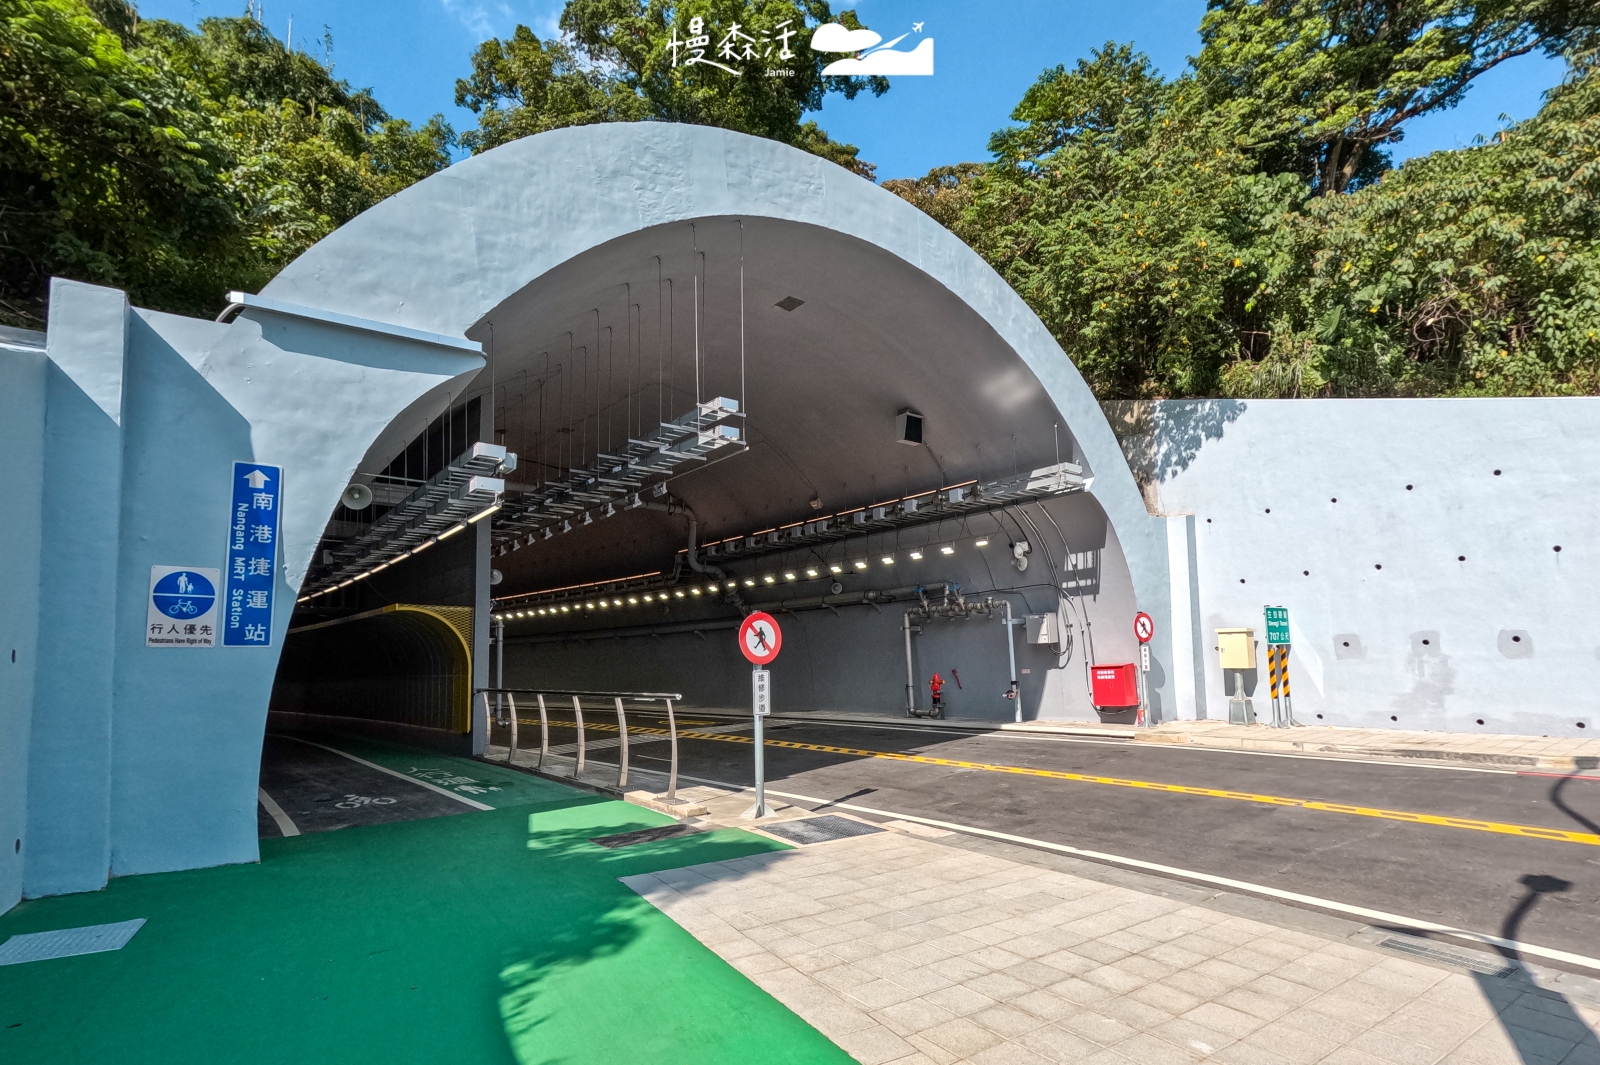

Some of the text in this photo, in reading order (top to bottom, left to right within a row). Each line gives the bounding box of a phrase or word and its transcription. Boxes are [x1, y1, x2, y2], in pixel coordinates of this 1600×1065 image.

[230, 502, 249, 629] Nangang MRT Station
[244, 492, 274, 642] 南港捷運站
[150, 623, 212, 636] 行人優先
